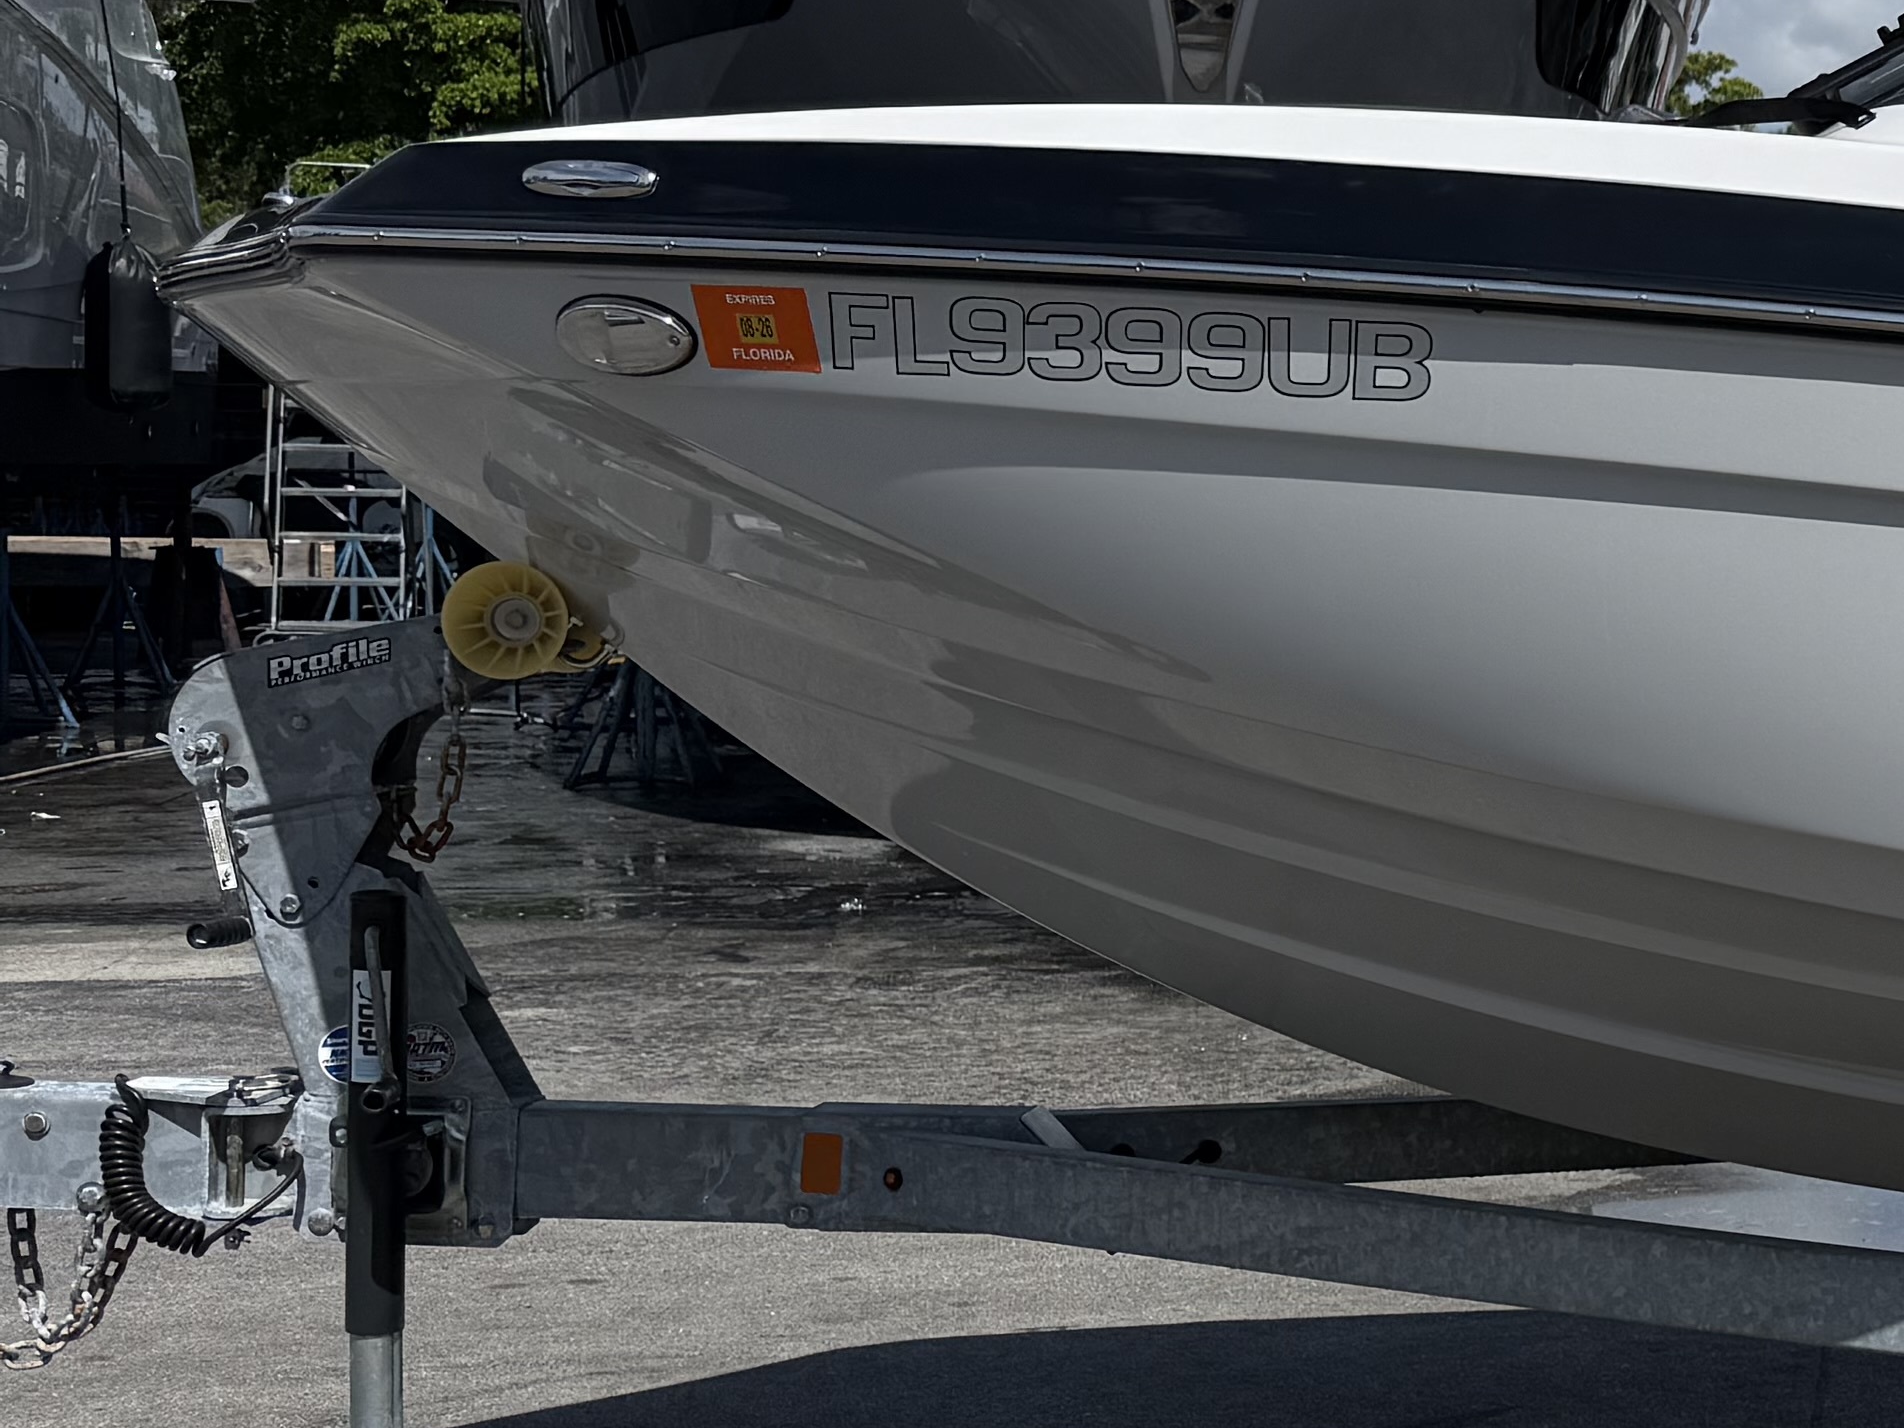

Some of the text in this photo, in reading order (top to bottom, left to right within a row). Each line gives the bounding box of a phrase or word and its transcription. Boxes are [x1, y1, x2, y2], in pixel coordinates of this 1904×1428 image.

[732, 347, 795, 361] FLORIDA
[828, 292, 1433, 400] FL9399UB
[269, 638, 390, 680] Profile
[271, 663, 348, 686] PERFORMANCE
